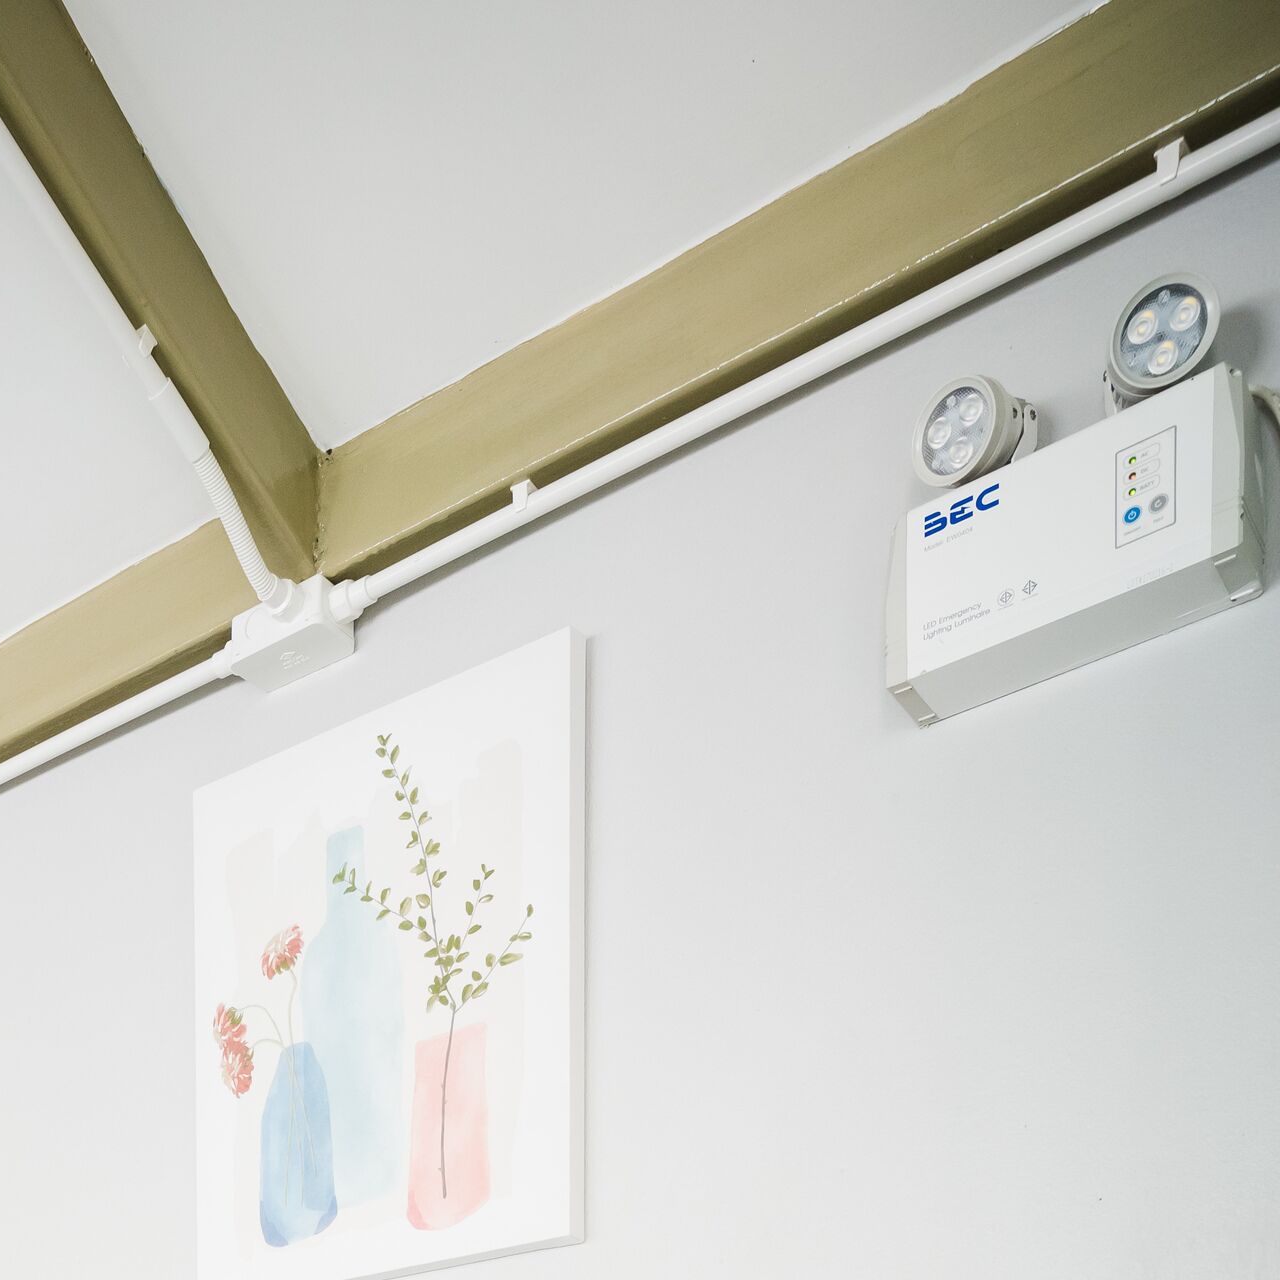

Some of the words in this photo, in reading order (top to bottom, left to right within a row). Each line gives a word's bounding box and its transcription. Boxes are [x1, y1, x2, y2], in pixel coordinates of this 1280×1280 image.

[923, 620, 937, 632] LED
[938, 602, 982, 625] Emergency
[923, 624, 953, 641] Lighting
[954, 608, 991, 629] Luminaire
